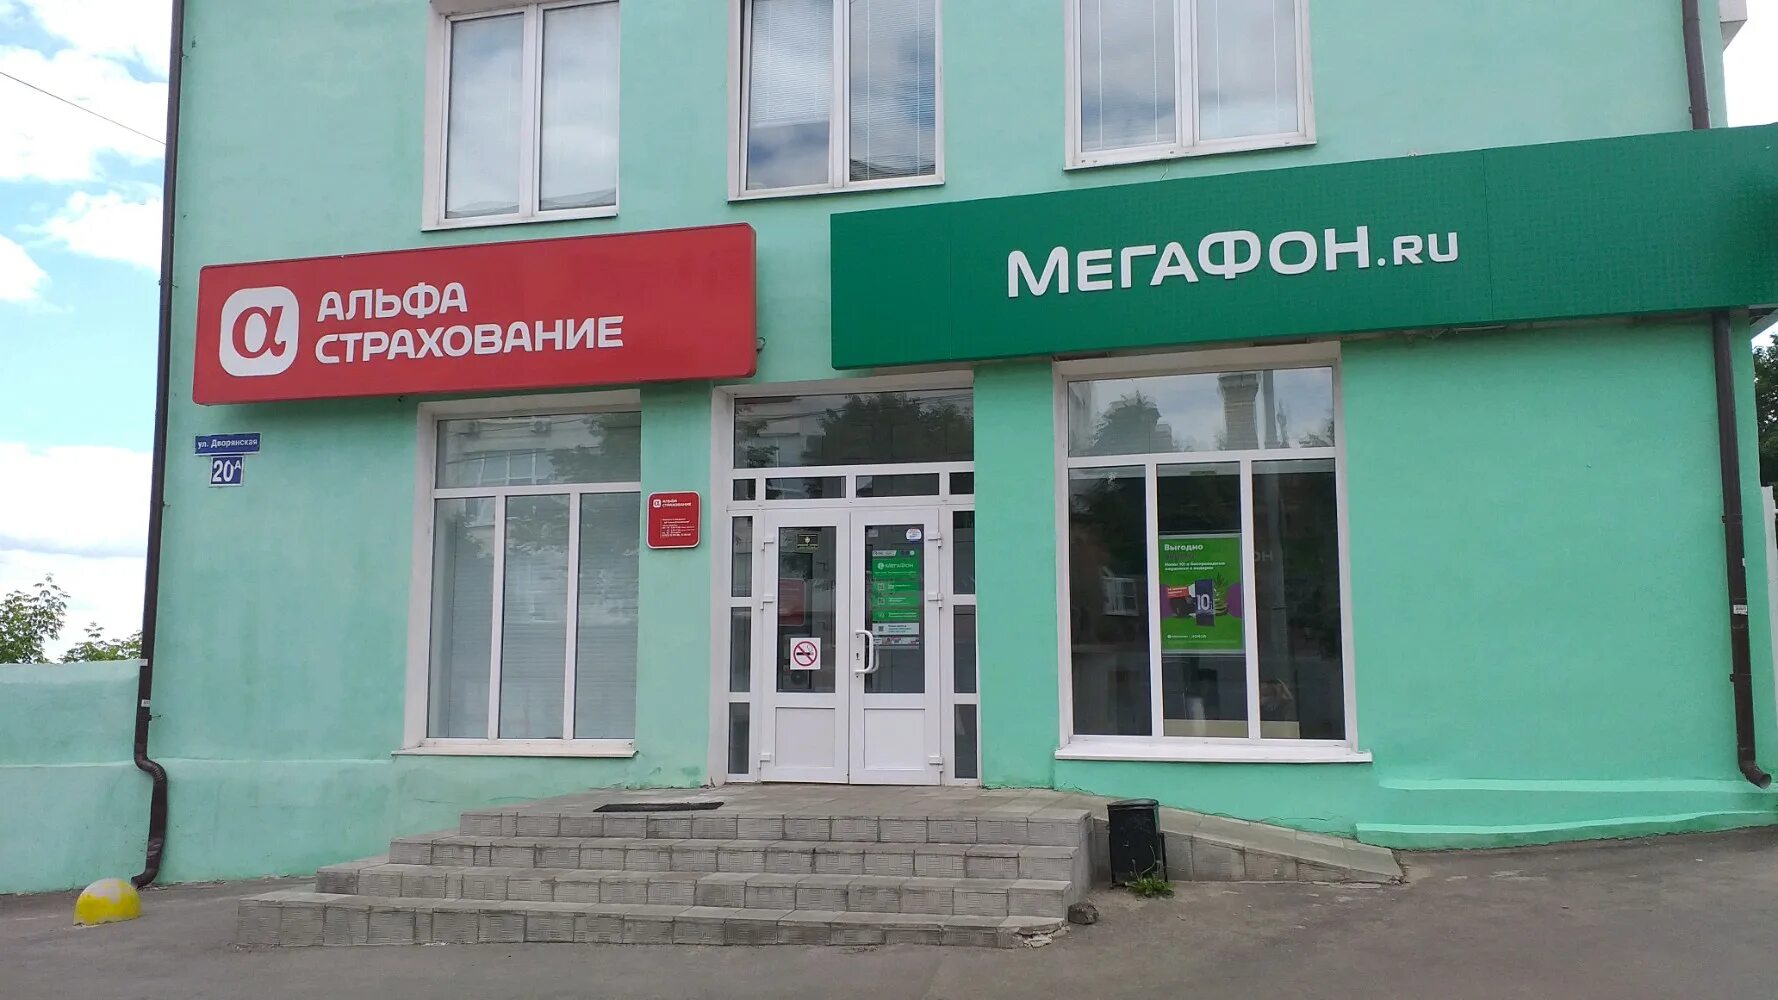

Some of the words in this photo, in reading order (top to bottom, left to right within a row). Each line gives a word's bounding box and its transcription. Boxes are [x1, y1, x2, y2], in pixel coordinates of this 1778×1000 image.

[316, 282, 468, 323] АЛЬФА
[315, 316, 624, 364] СТРАХОВАНИЕ
[198, 441, 209, 450] ул.
[210, 439, 258, 449] Дворянская
[1164, 543, 1204, 552] Выгодно
